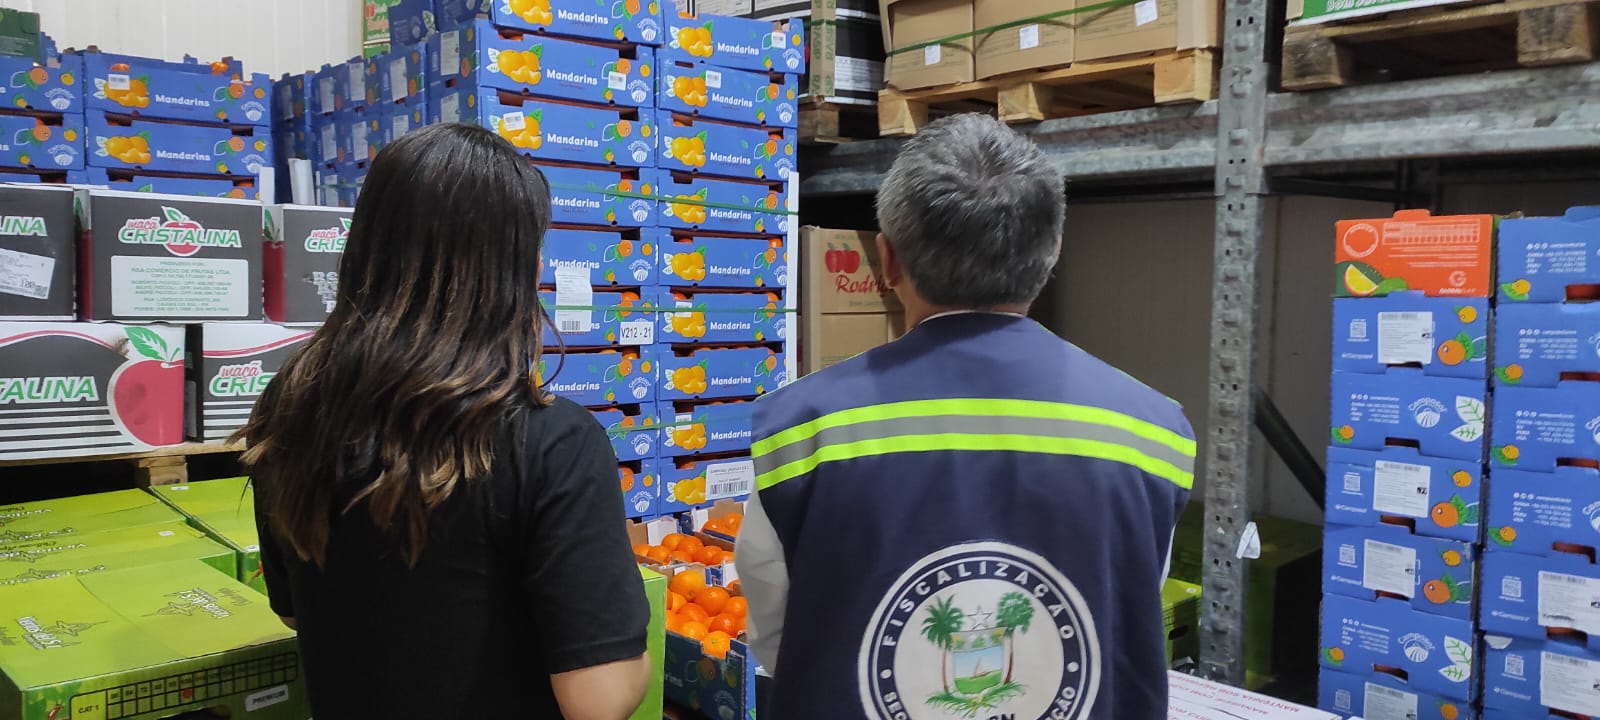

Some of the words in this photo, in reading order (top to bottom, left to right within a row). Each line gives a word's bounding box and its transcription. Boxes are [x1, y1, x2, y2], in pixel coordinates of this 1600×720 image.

[558, 9, 608, 25] Mandarins
[717, 42, 759, 56] Mandarins
[546, 69, 598, 85] Mandarins
[154, 94, 210, 108] Mandarins
[712, 93, 753, 108] Mandarins
[547, 133, 599, 147] Mandarins
[156, 149, 211, 162] Mandarins
[710, 151, 751, 165] Mandarins
[551, 196, 600, 208] Mandarins
[710, 208, 751, 220] Mandarins
[119, 228, 241, 246] CRISTALINA
[549, 258, 600, 269] Mandarins
[709, 265, 751, 275] Mandarins
[710, 321, 751, 330] Mandarins
[621, 327, 638, 338] V212
[643, 327, 651, 338] 21
[221, 360, 262, 381] maçã
[549, 382, 600, 392] Mandarins
[711, 376, 752, 386] Mandarins
[711, 430, 752, 440] Mandarins
[882, 561, 1074, 647] FISCALIZAÇÃO
[78, 706, 93, 714] CAT
